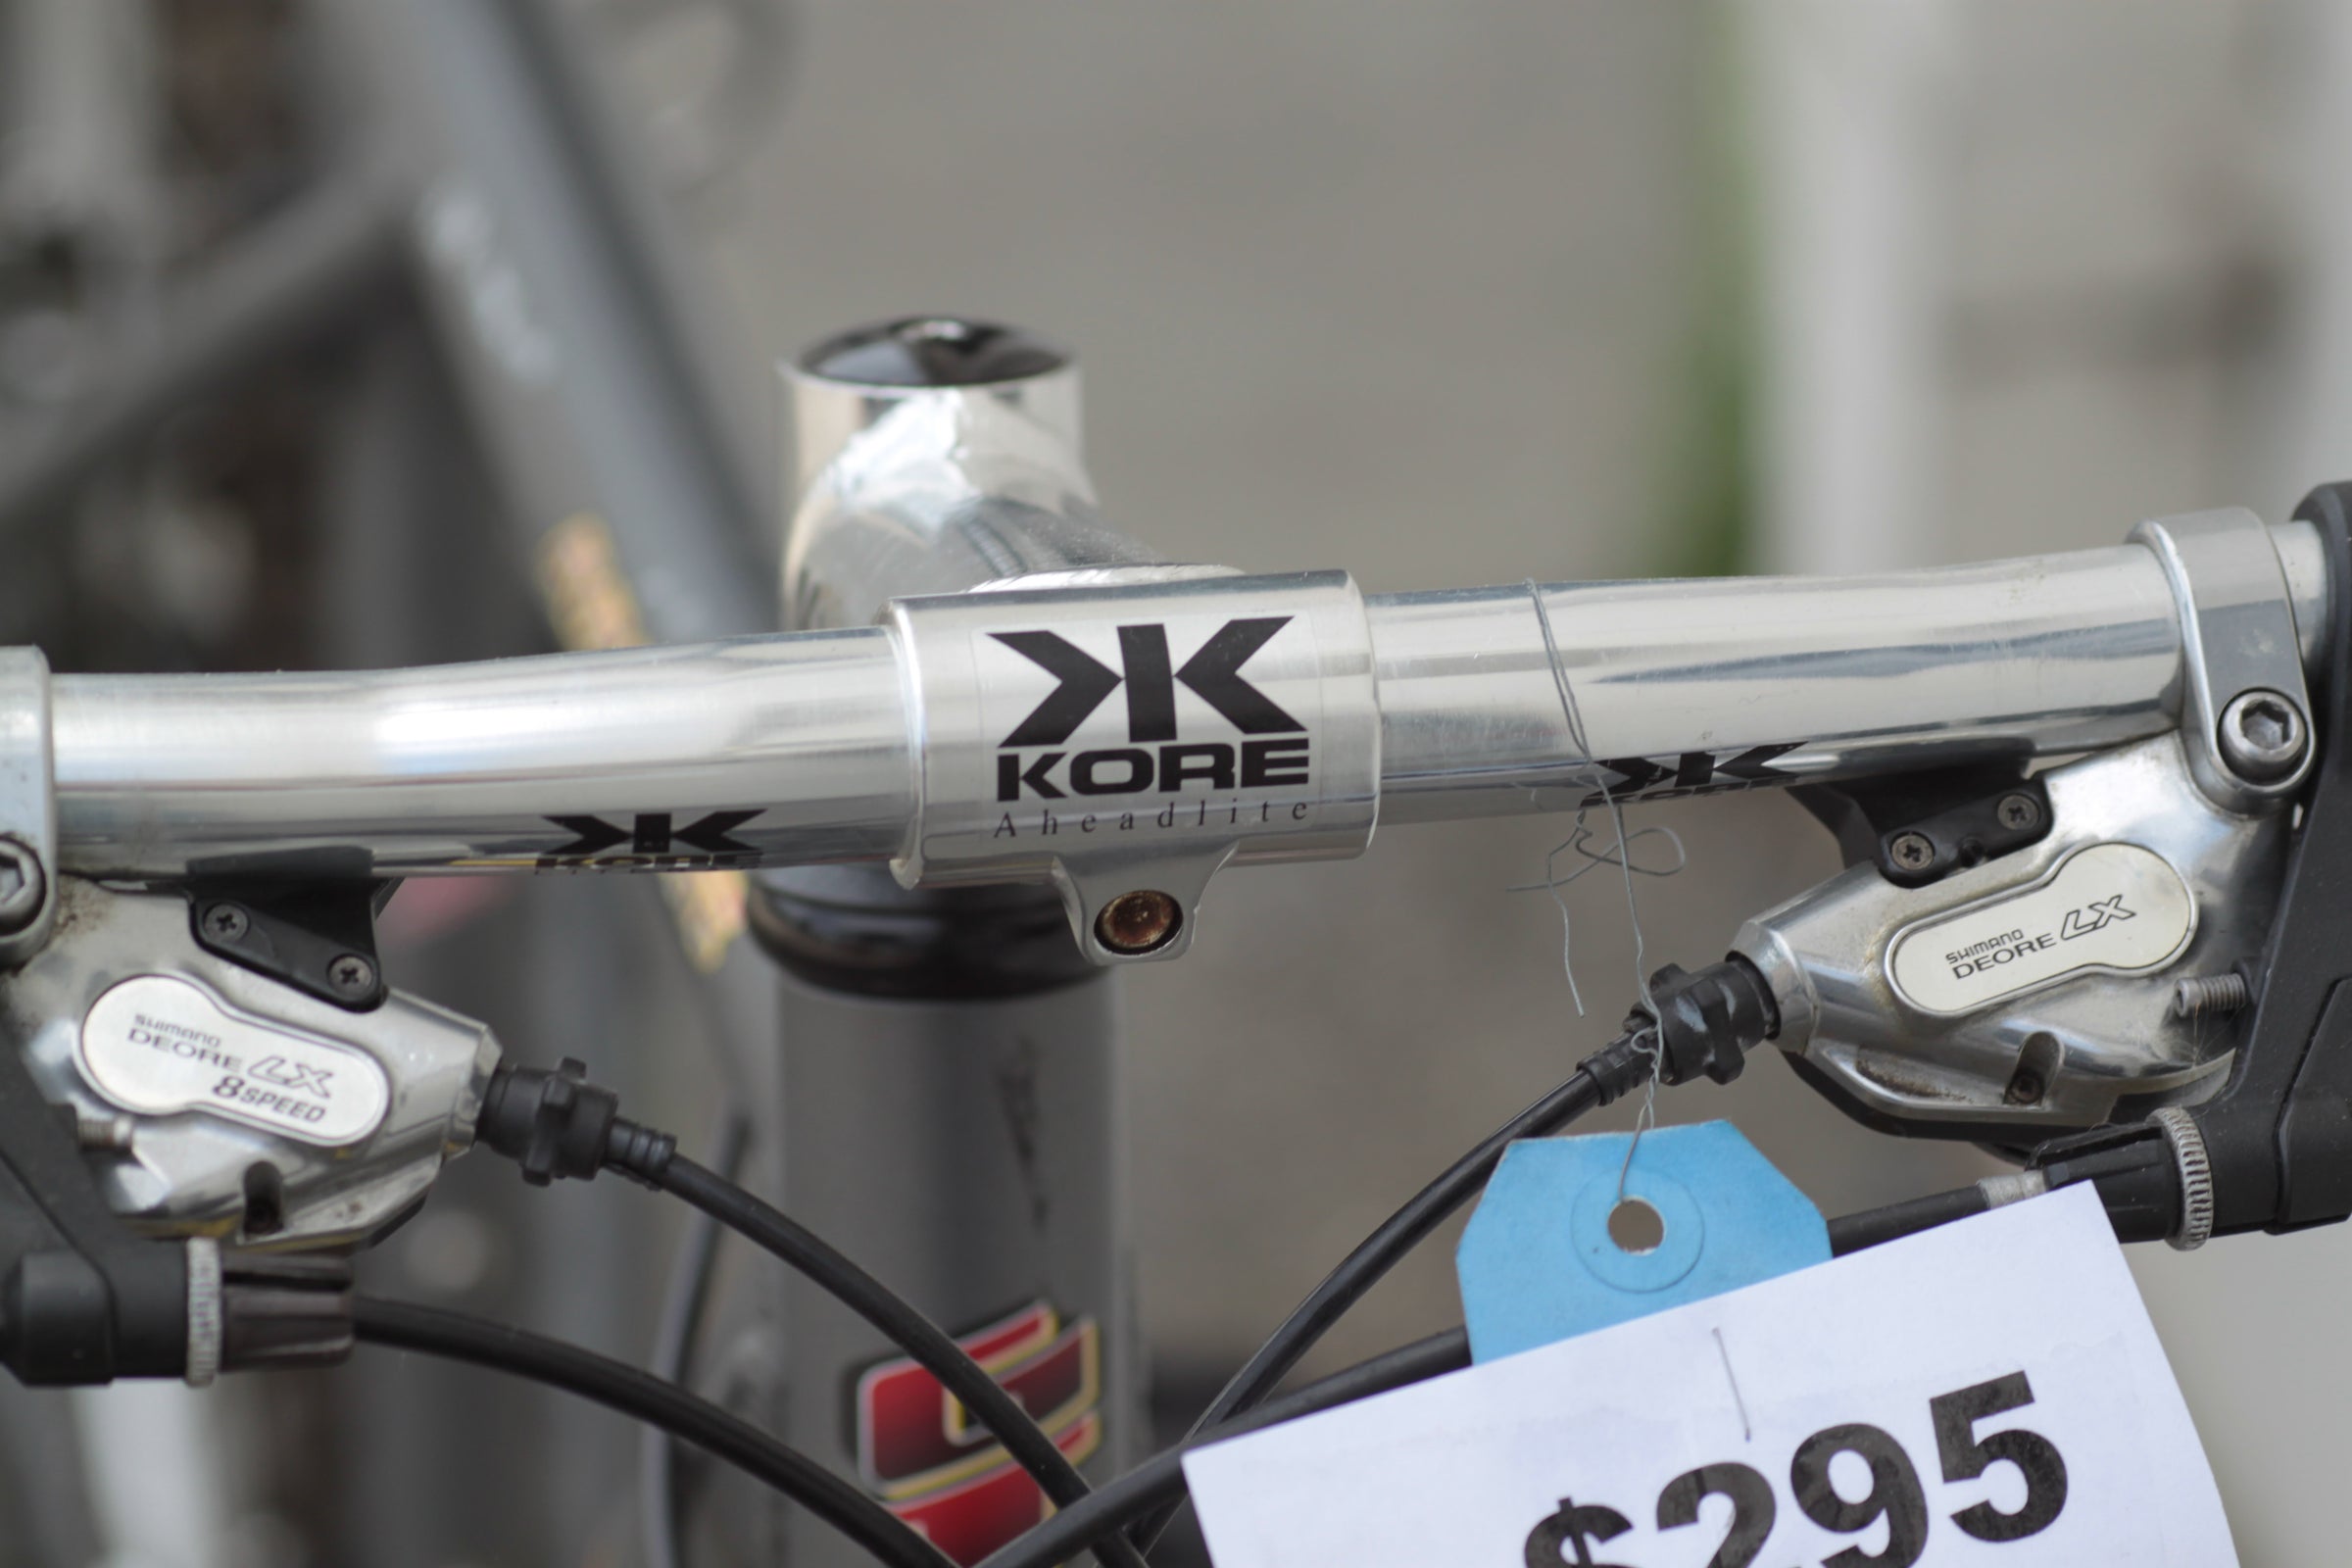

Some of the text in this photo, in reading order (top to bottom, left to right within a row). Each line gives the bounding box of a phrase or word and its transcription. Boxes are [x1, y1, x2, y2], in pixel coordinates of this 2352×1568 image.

[996, 737, 1310, 803] KORE
[993, 797, 1309, 840] Aheadlite
[1945, 929, 2024, 964] SHIMANO
[1952, 894, 2136, 979] DEORE LX
[134, 1013, 221, 1048] SHIMANO
[128, 1028, 332, 1098] DEORE LX
